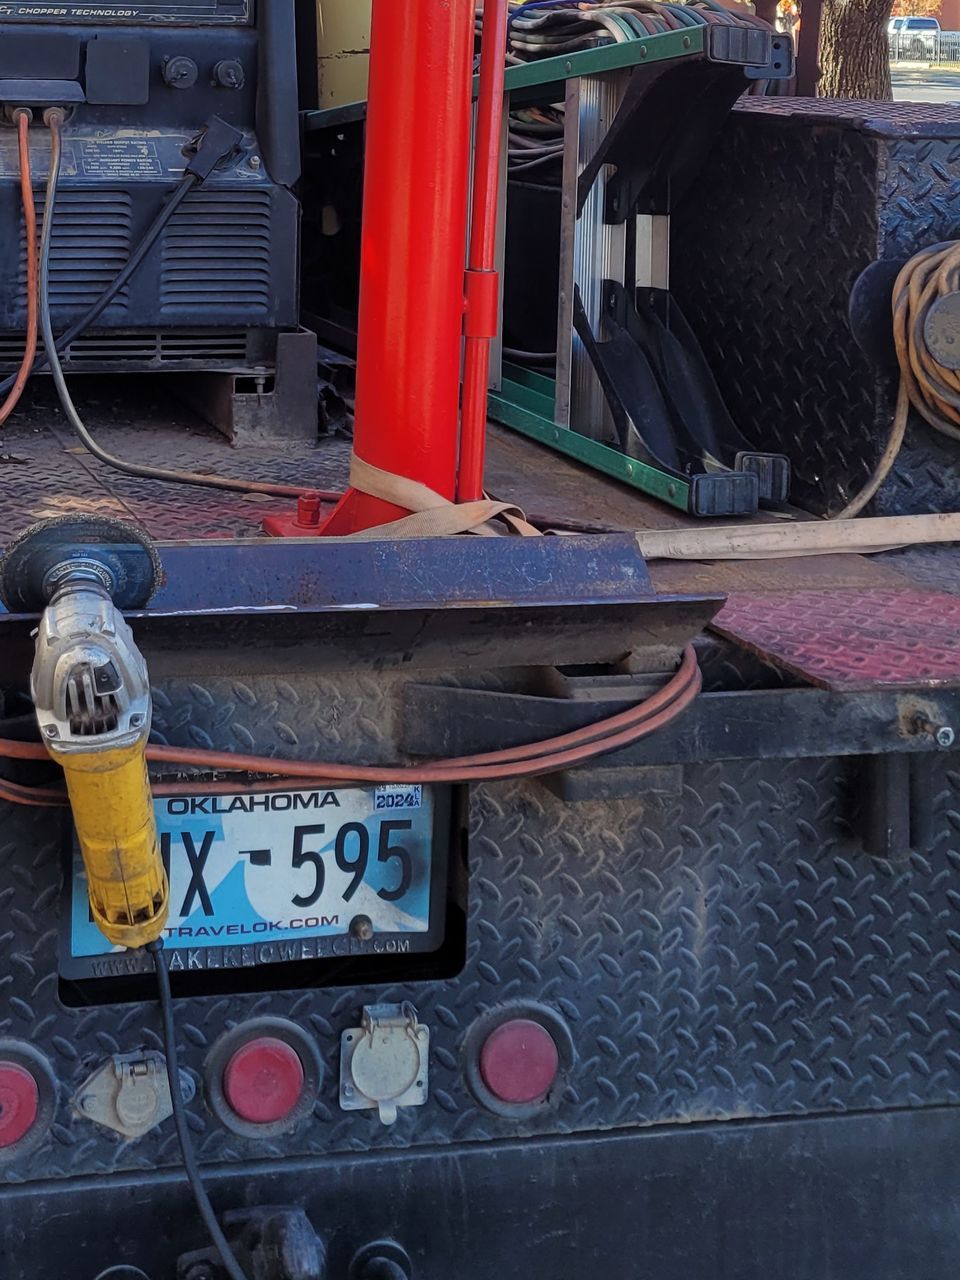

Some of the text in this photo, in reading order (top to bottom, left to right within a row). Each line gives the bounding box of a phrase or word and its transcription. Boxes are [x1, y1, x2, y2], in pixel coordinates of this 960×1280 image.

[18, 7, 67, 15] CHOPPER
[71, 8, 140, 17] TECHNOLOGY
[167, 791, 341, 816] OKLAHOMA
[376, 792, 414, 808] 2024
[163, 915, 339, 938] TRAVELOK.COM
